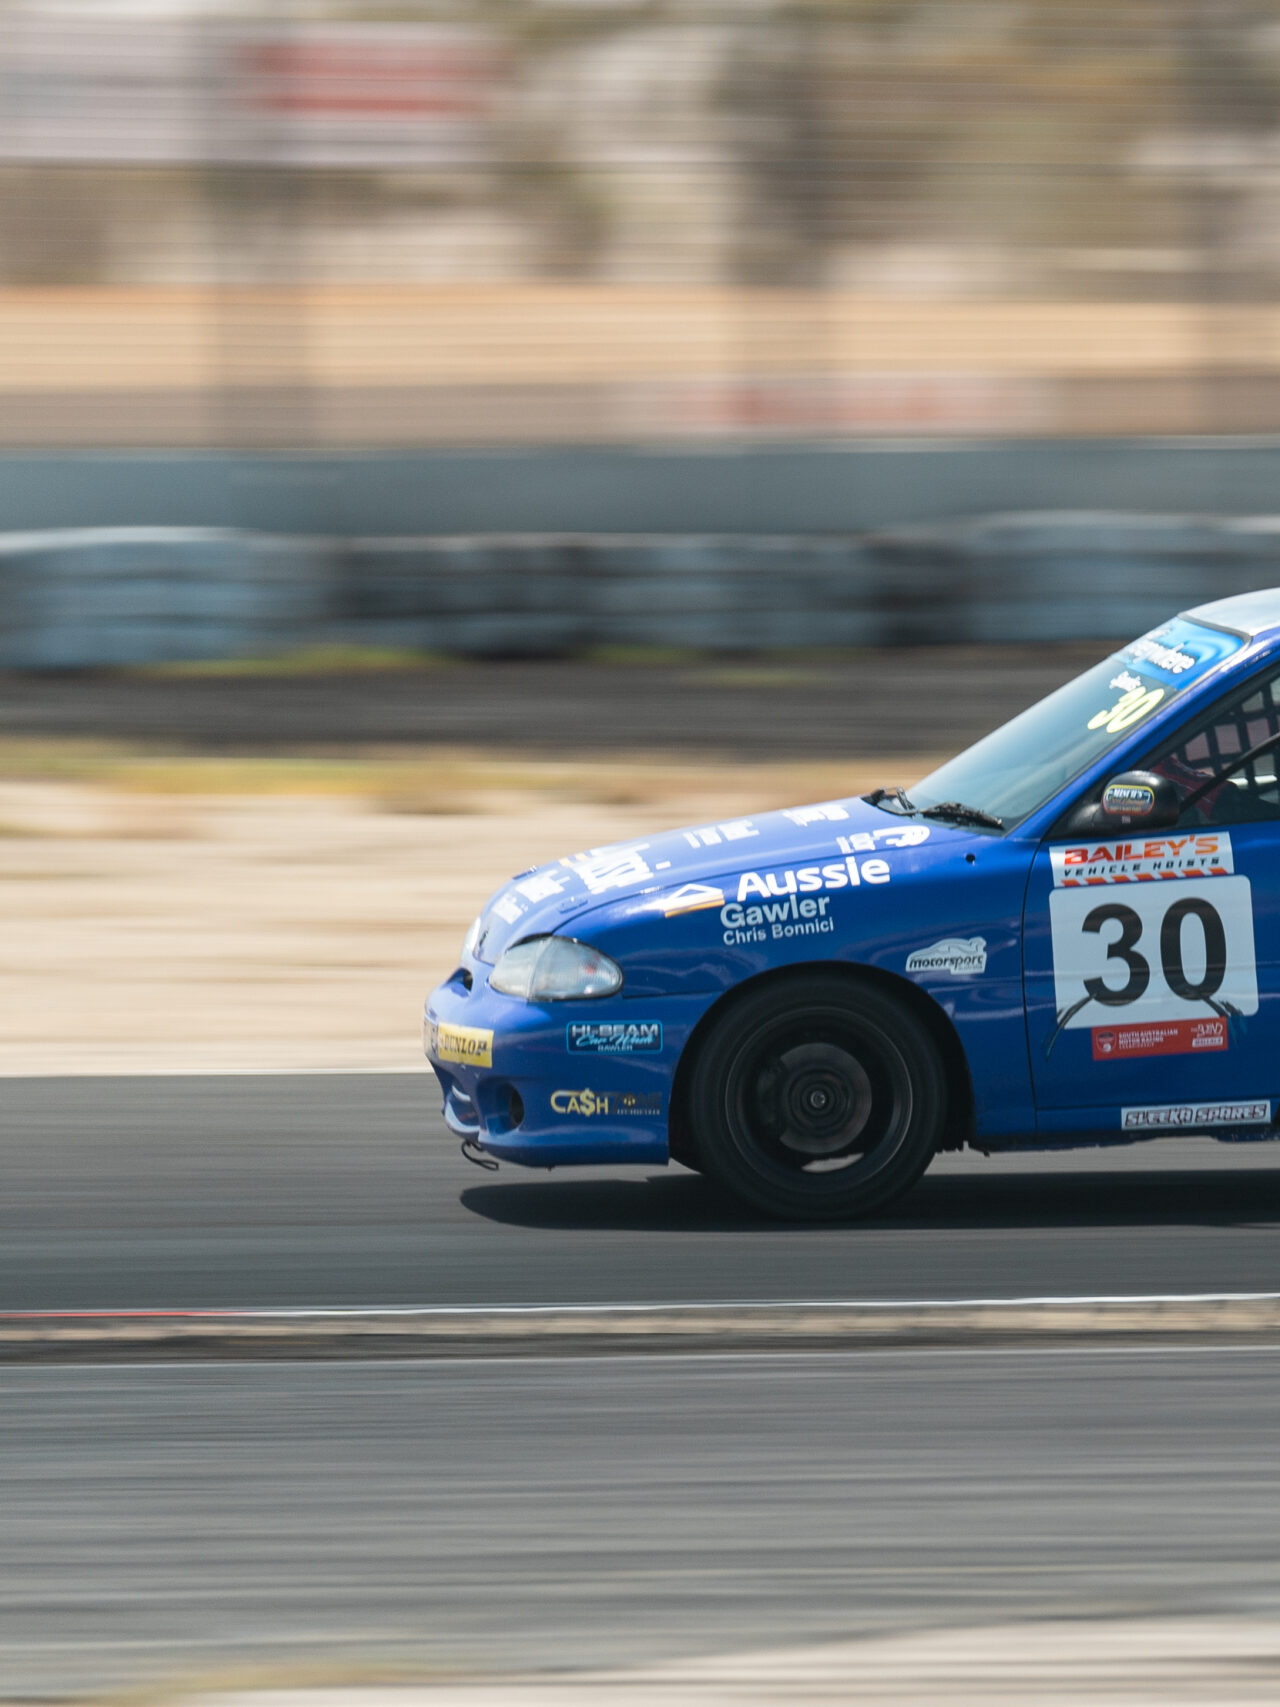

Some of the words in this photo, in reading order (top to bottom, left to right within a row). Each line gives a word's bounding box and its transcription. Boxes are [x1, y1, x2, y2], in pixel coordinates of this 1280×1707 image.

[1087, 685, 1165, 733] 30
[1064, 834, 1219, 865] BAILEY'S
[737, 857, 891, 902] Aussie
[1064, 863, 1141, 877] VEHICLE
[1153, 857, 1220, 870] HOISTS
[720, 893, 831, 929] Gawler
[723, 926, 768, 946] Chris
[771, 916, 835, 940] Bonnici
[909, 955, 984, 971] motorsport
[1082, 897, 1227, 1007] 30
[571, 1023, 659, 1037] HI-BEAM
[1194, 1104, 1267, 1123] SPARES
